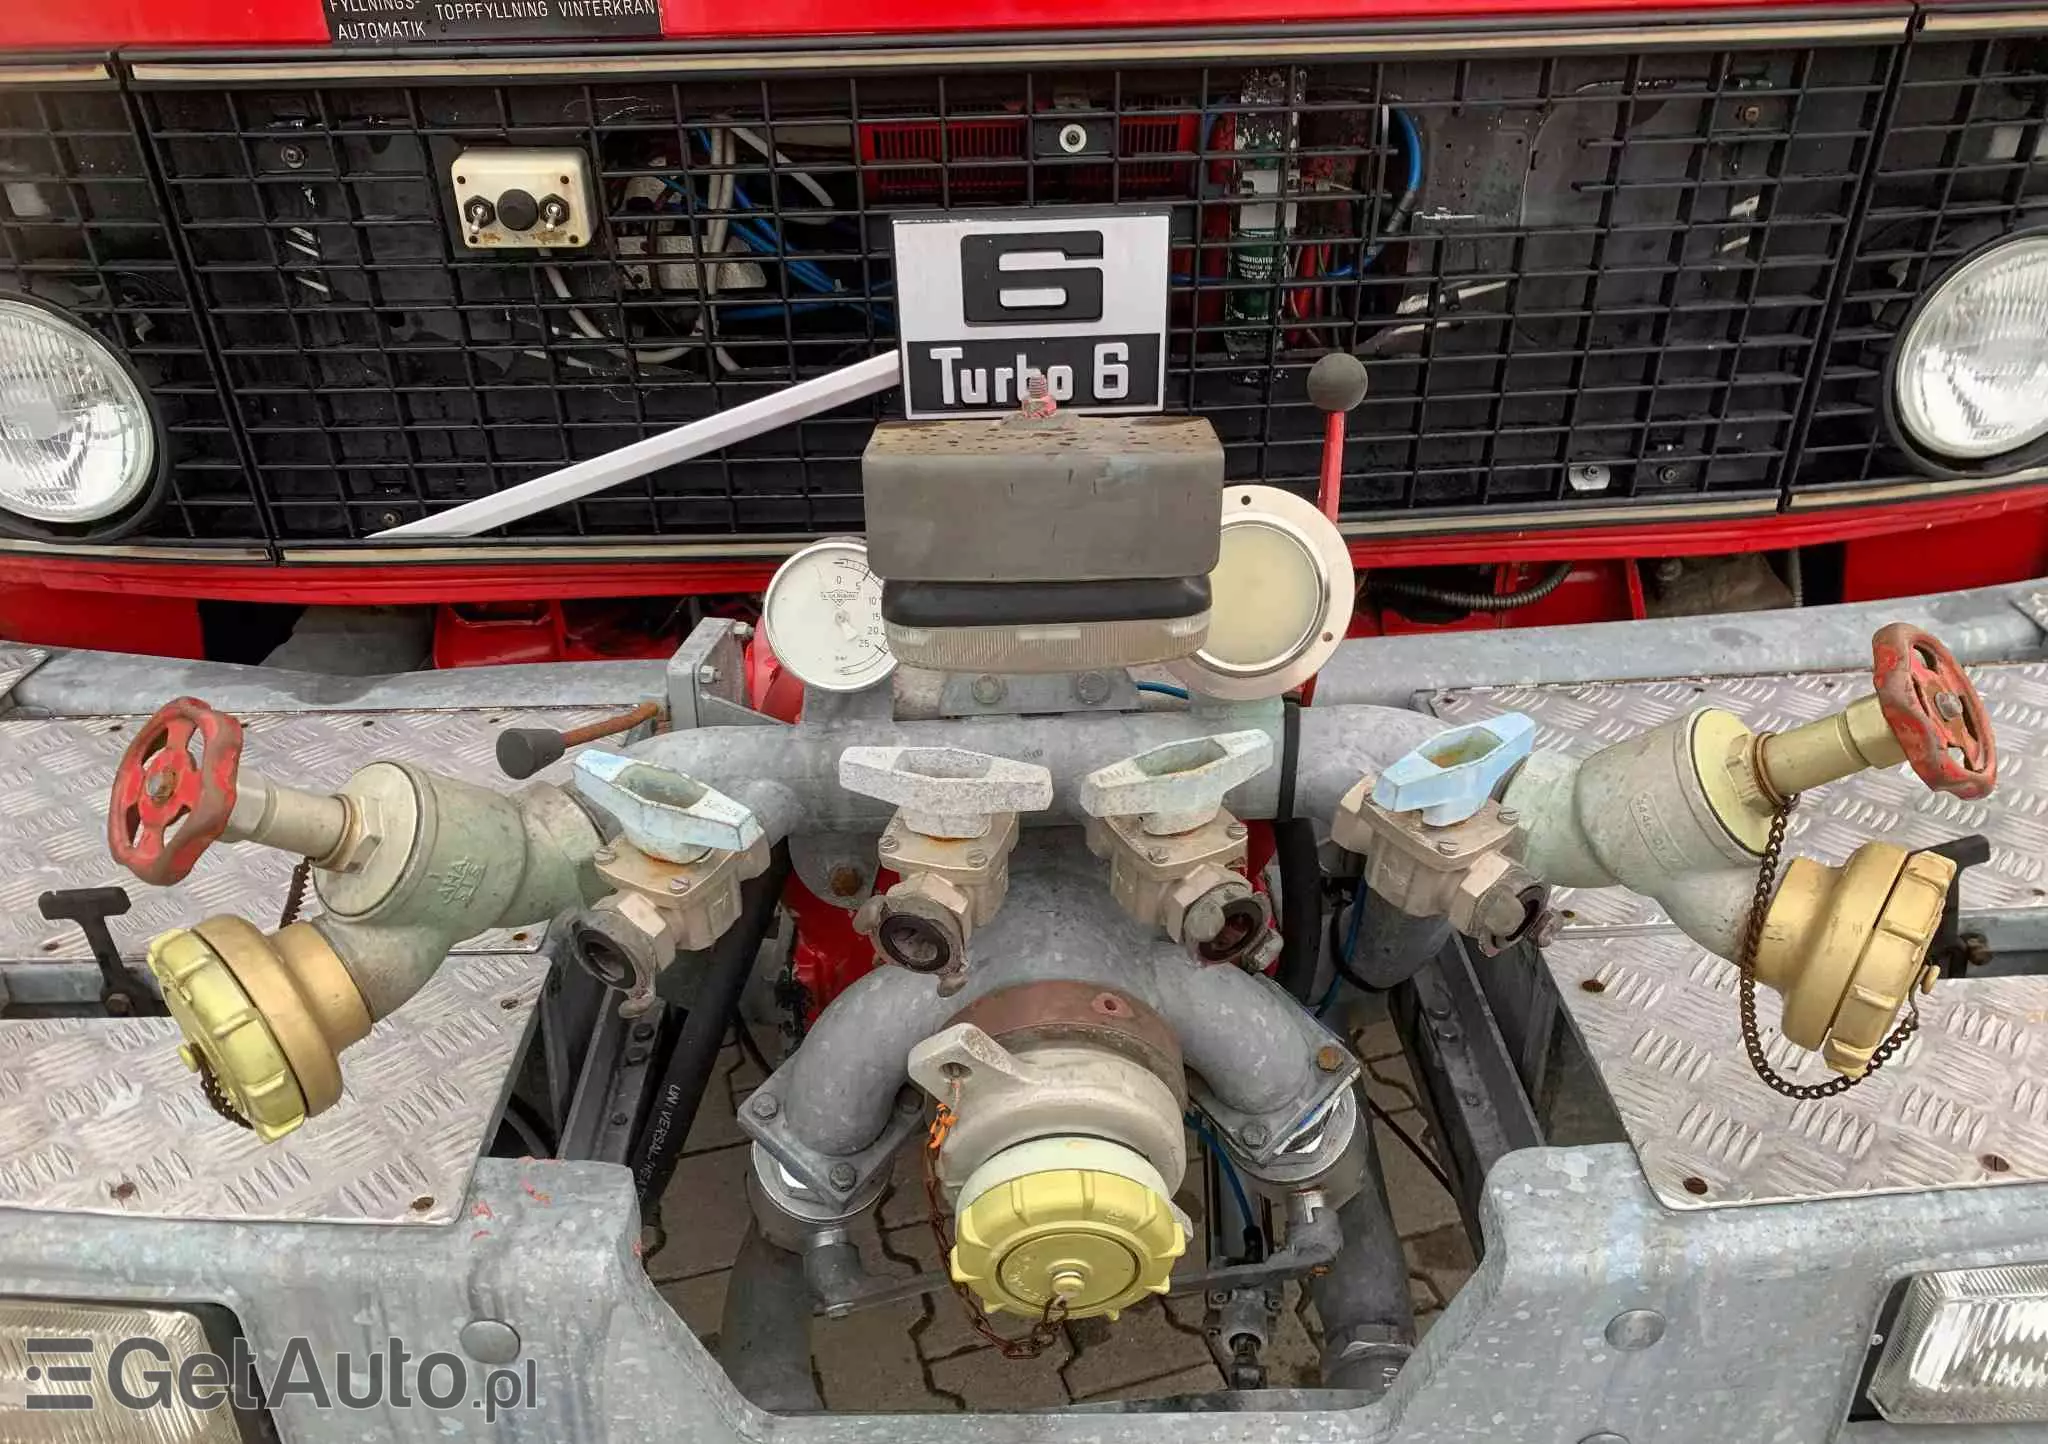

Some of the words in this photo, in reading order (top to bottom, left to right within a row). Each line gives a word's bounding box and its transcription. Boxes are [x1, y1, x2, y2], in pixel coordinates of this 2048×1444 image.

[435, 1, 548, 20] TOPPFYLLNING
[558, 0, 655, 17] VINTERKRAN
[338, 20, 426, 40] AUTOMATIK
[961, 230, 1104, 327] 6
[929, 346, 1073, 405] Turbo
[1093, 341, 1129, 400] 6
[872, 612, 881, 621] 15
[867, 626, 879, 635] 20
[859, 639, 870, 648] 25
